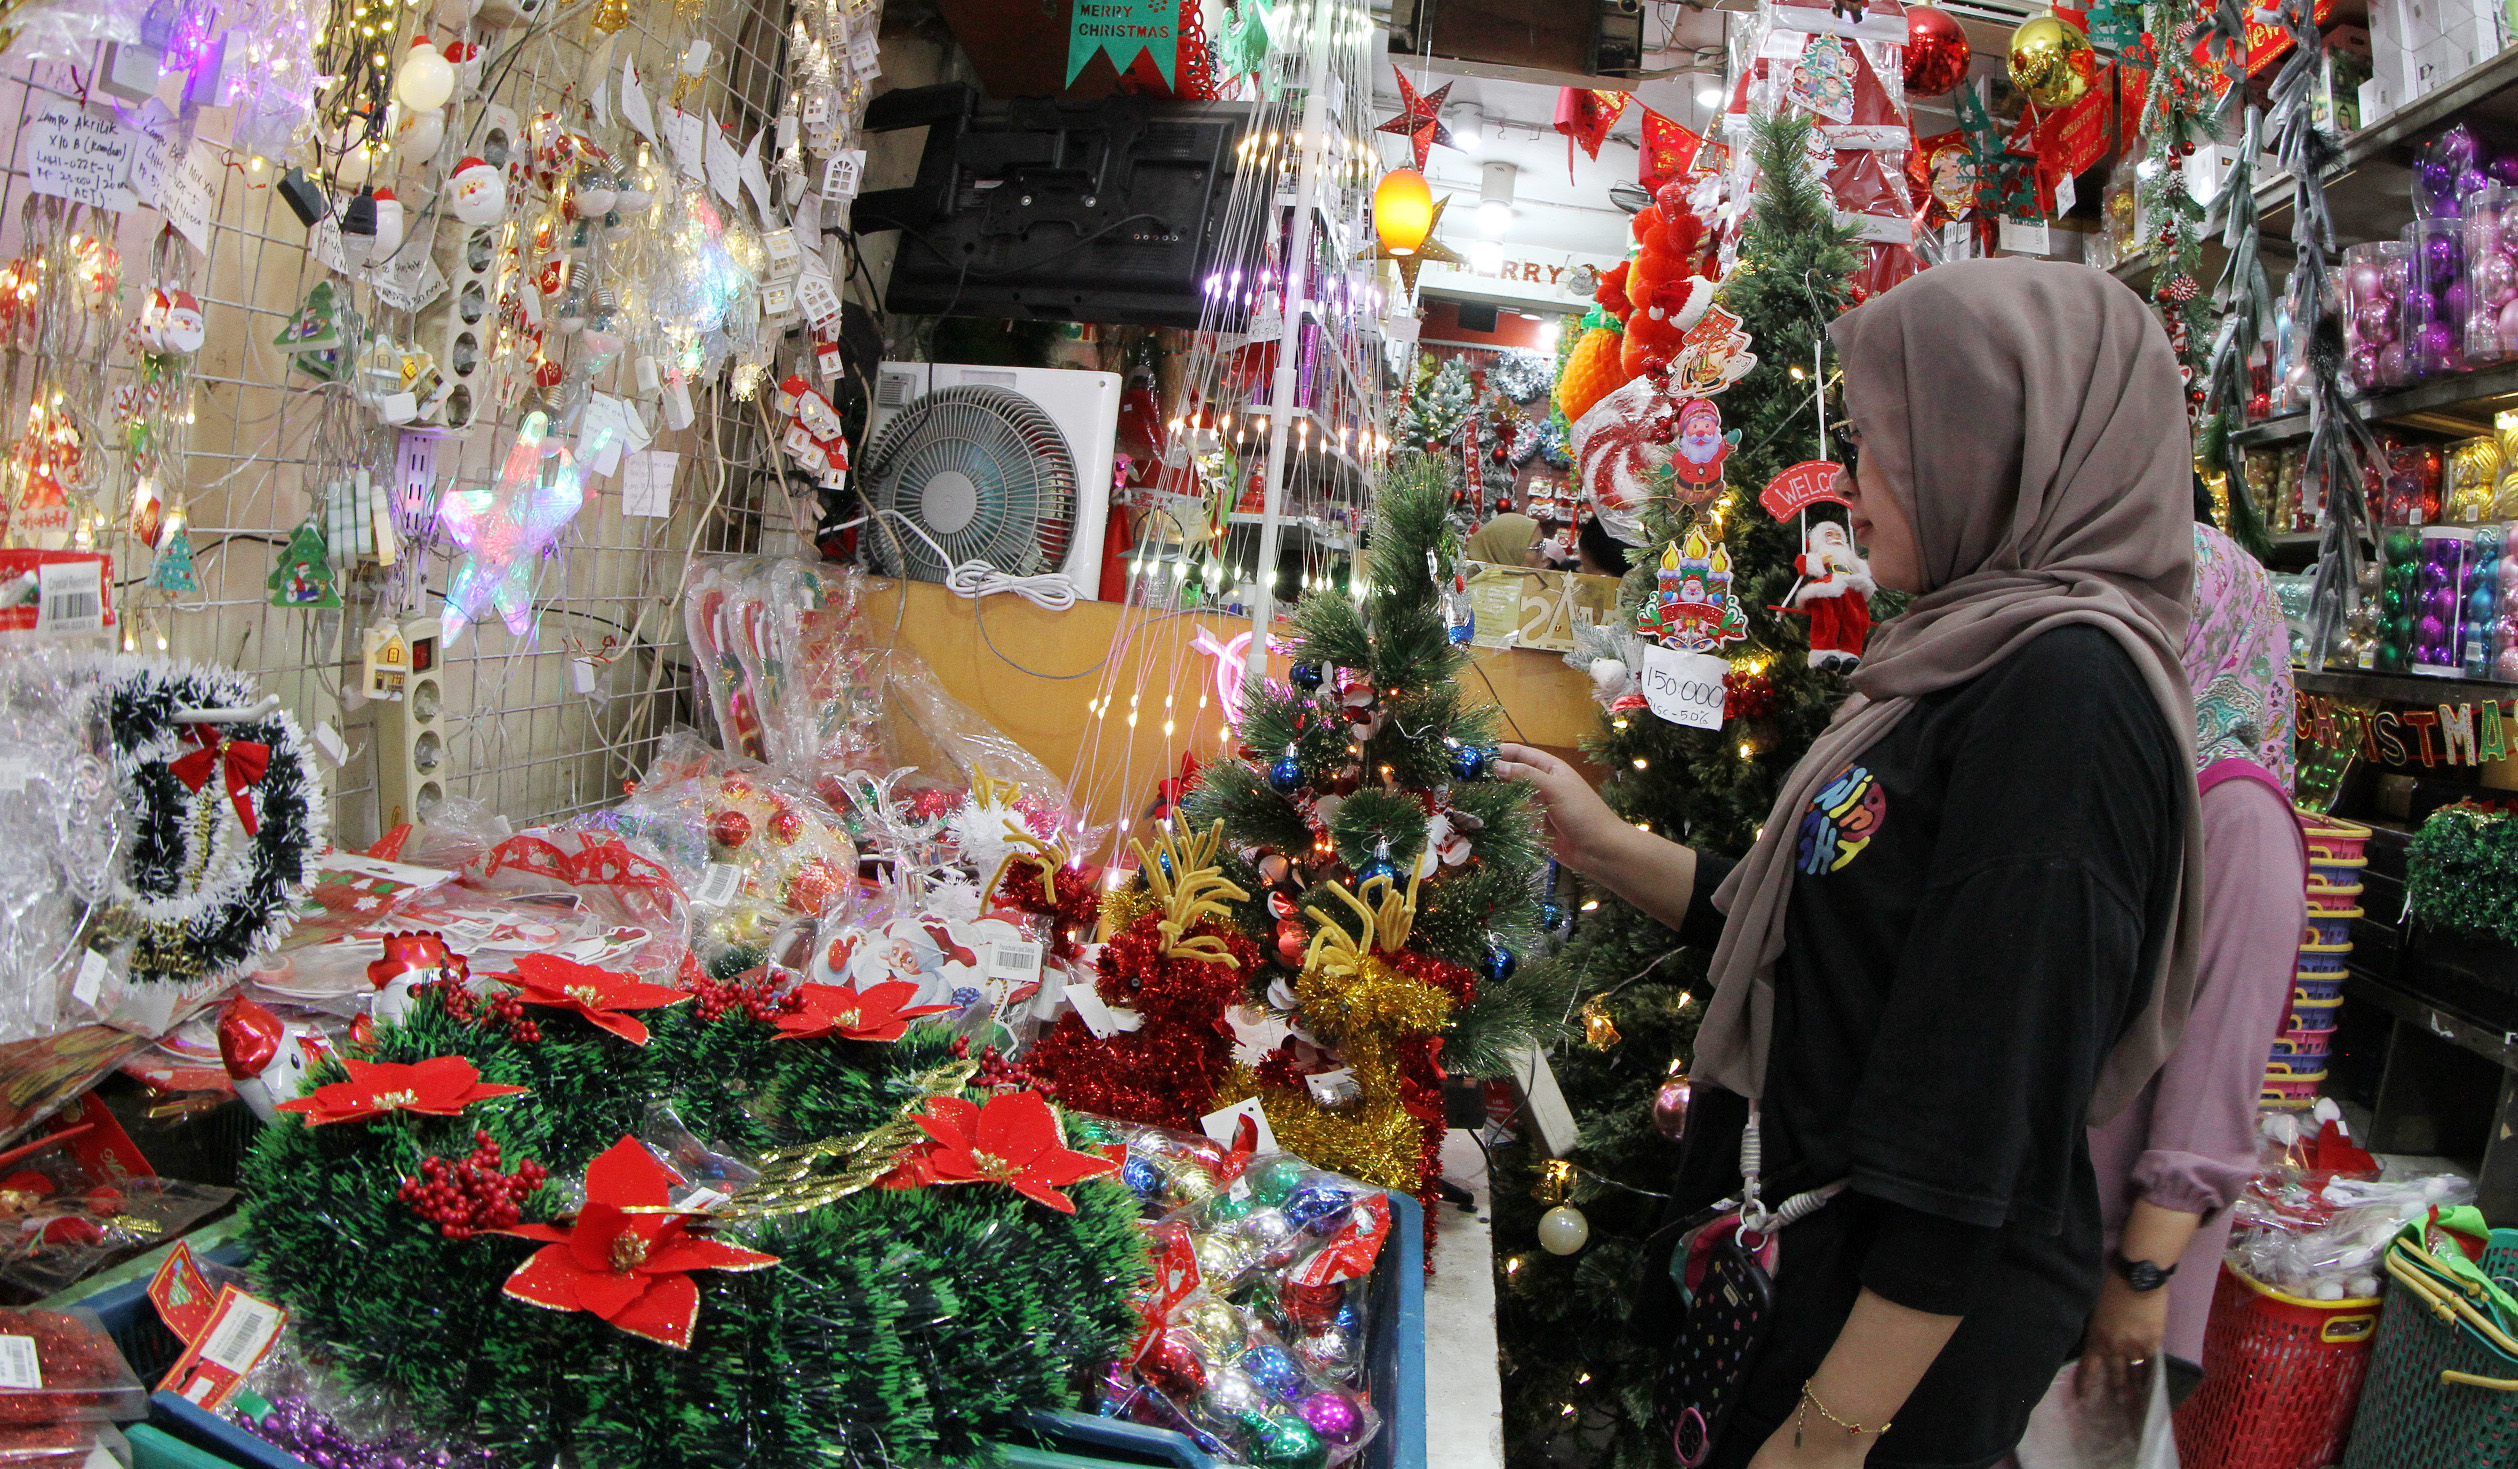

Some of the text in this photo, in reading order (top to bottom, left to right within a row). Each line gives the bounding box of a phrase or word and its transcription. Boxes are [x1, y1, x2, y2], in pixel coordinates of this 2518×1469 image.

[1080, 4, 1133, 18] MERRY
[1079, 23, 1169, 38] CHRISTMAS
[1455, 257, 1564, 285] MRRY
[1774, 472, 1837, 506] WELC
[1647, 666, 1724, 709] 150.000
[2295, 689, 2518, 767] CHRISTMA
